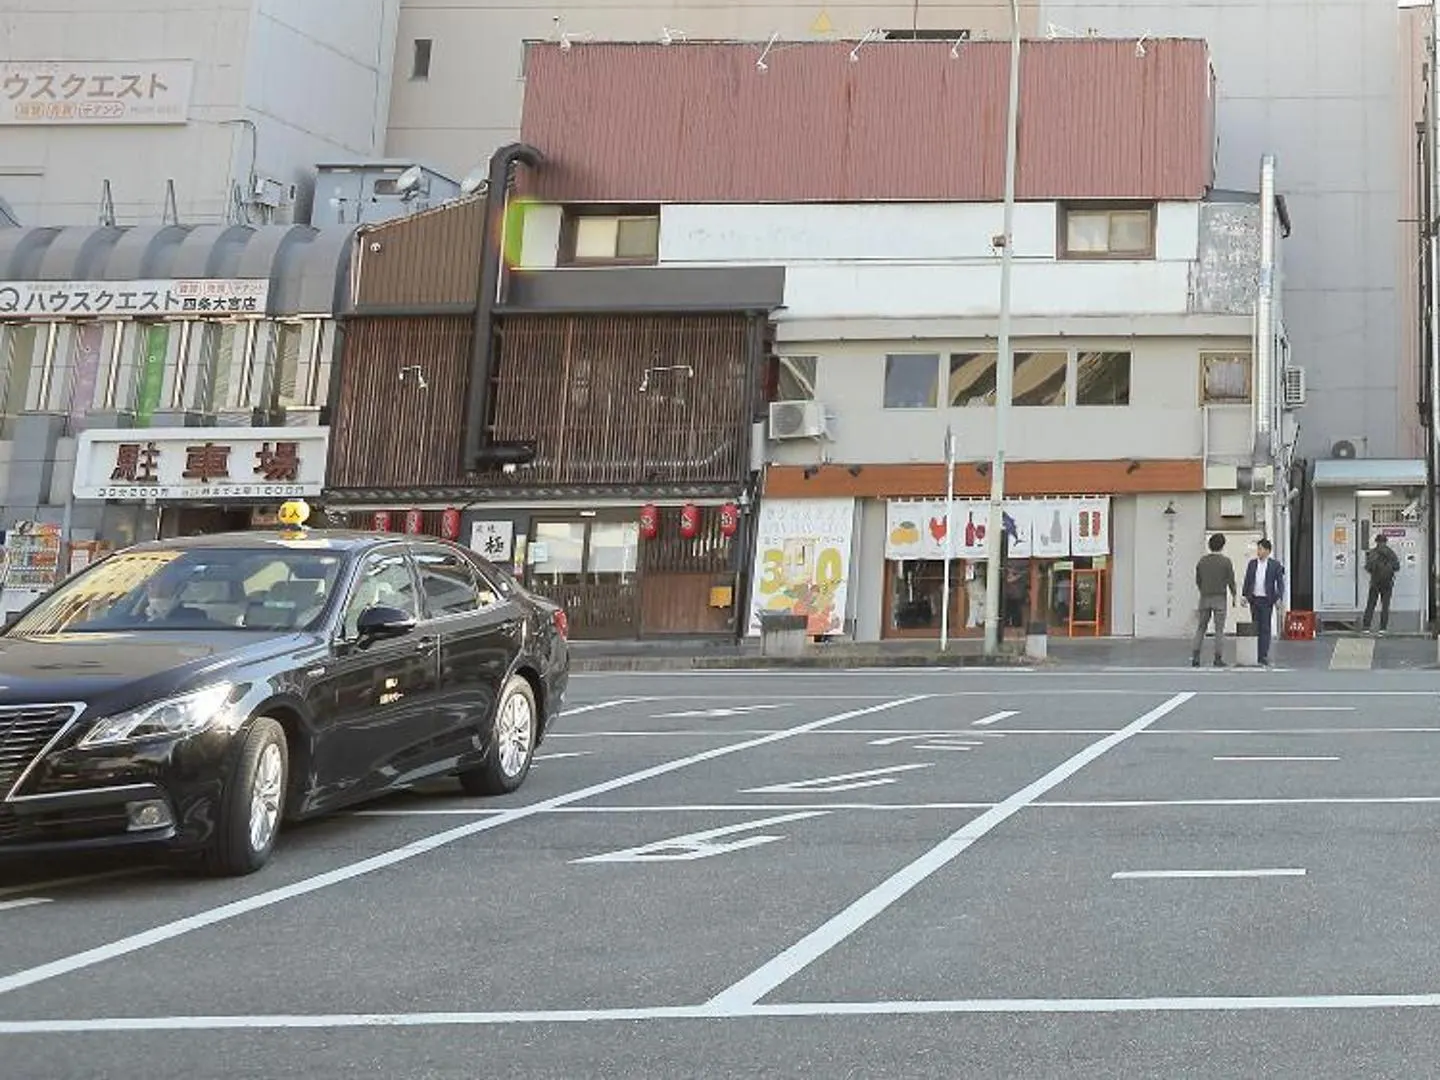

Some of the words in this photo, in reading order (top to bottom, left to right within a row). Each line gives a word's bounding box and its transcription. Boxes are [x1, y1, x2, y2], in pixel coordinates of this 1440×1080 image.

[24, 290, 179, 312] ハウスクエスト
[182, 296, 257, 310] 四条大宮店
[110, 441, 302, 483] 駐車場
